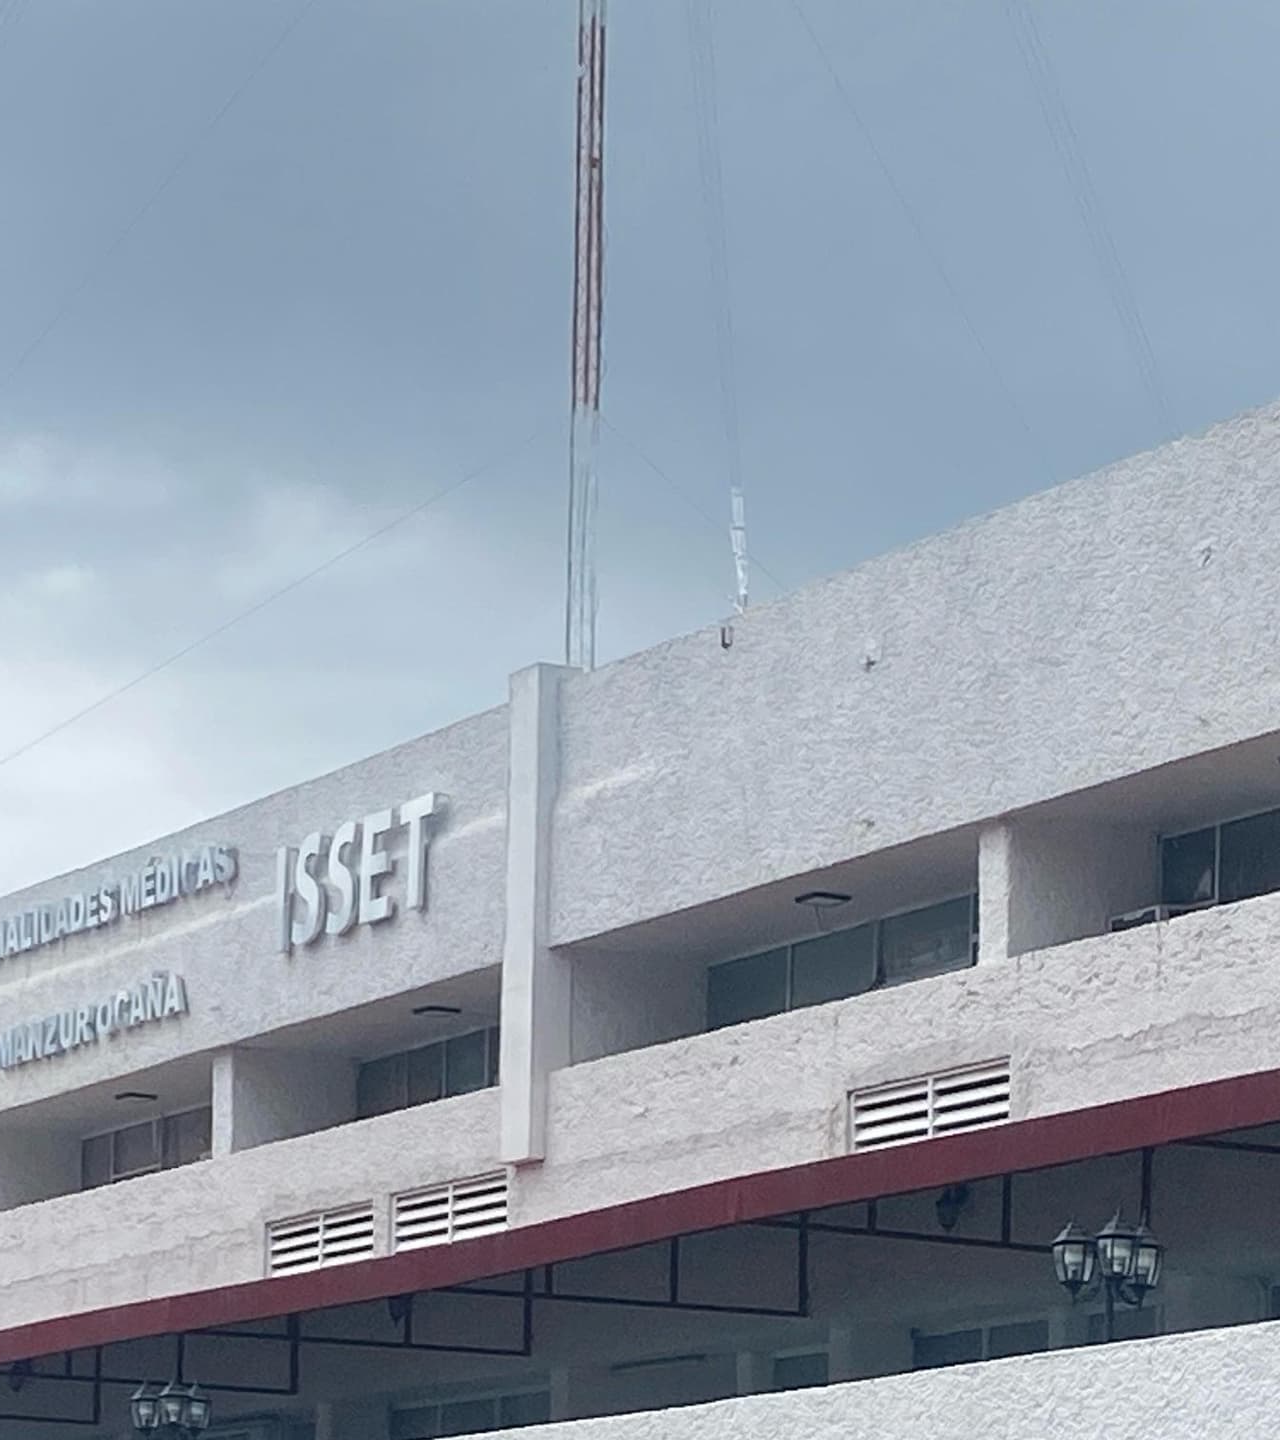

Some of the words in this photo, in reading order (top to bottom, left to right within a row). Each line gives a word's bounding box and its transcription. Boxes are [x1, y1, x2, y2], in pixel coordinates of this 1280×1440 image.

[120, 847, 236, 916] MÉDICAS
[274, 791, 442, 953] ISSET
[0, 1007, 96, 1069] MANZUR
[94, 974, 186, 1035] OCAÑA
